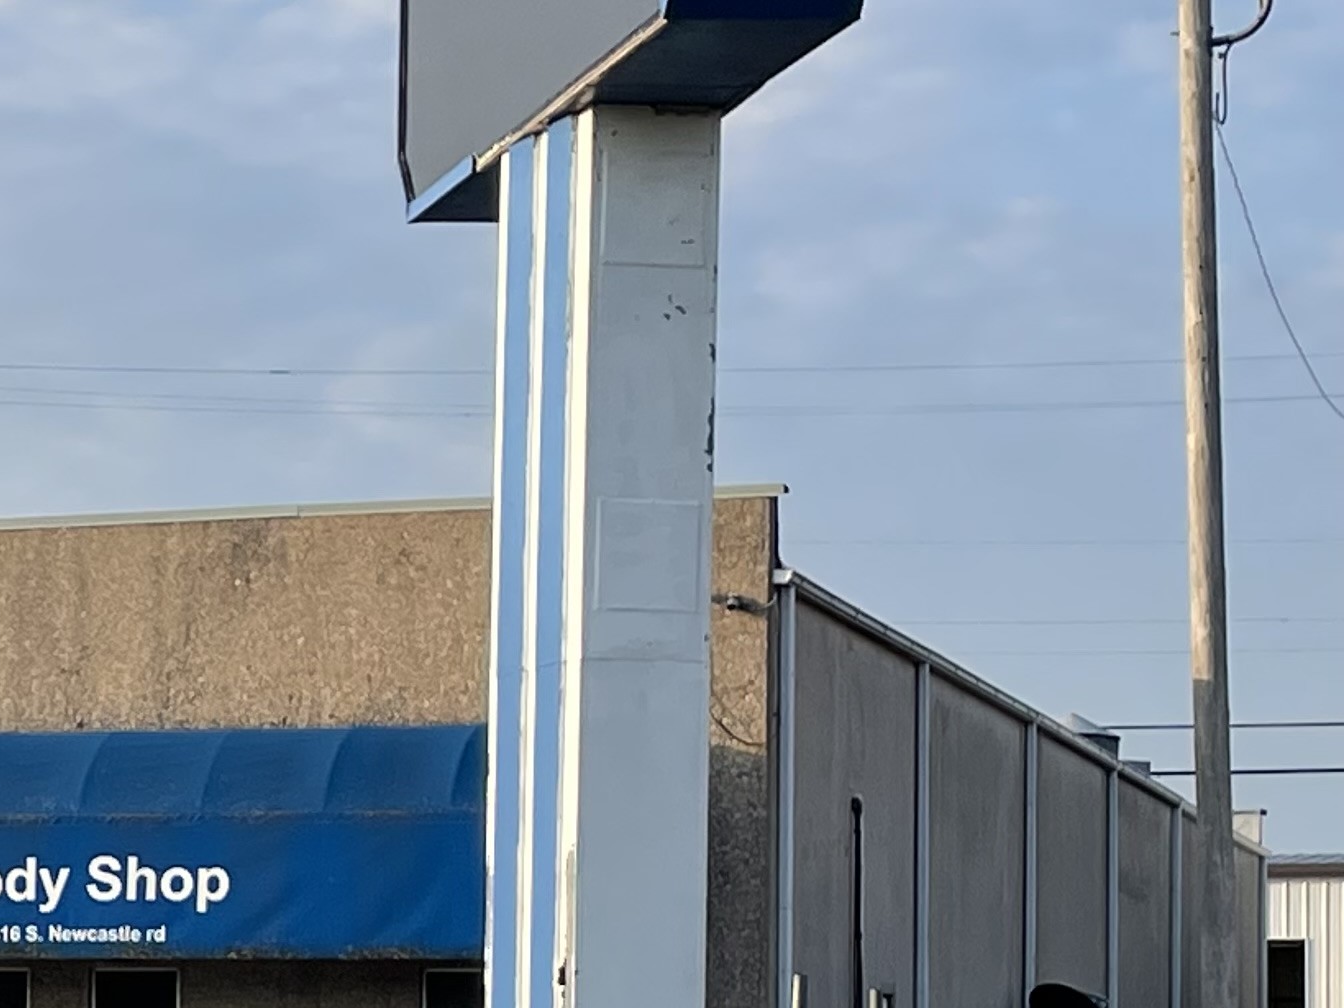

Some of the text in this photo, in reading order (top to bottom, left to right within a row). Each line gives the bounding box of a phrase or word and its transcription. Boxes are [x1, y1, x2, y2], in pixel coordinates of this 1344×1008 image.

[86, 855, 230, 913] Shop
[25, 925, 44, 943] S.
[48, 924, 141, 943] Newcastle
[146, 924, 167, 943] rd
